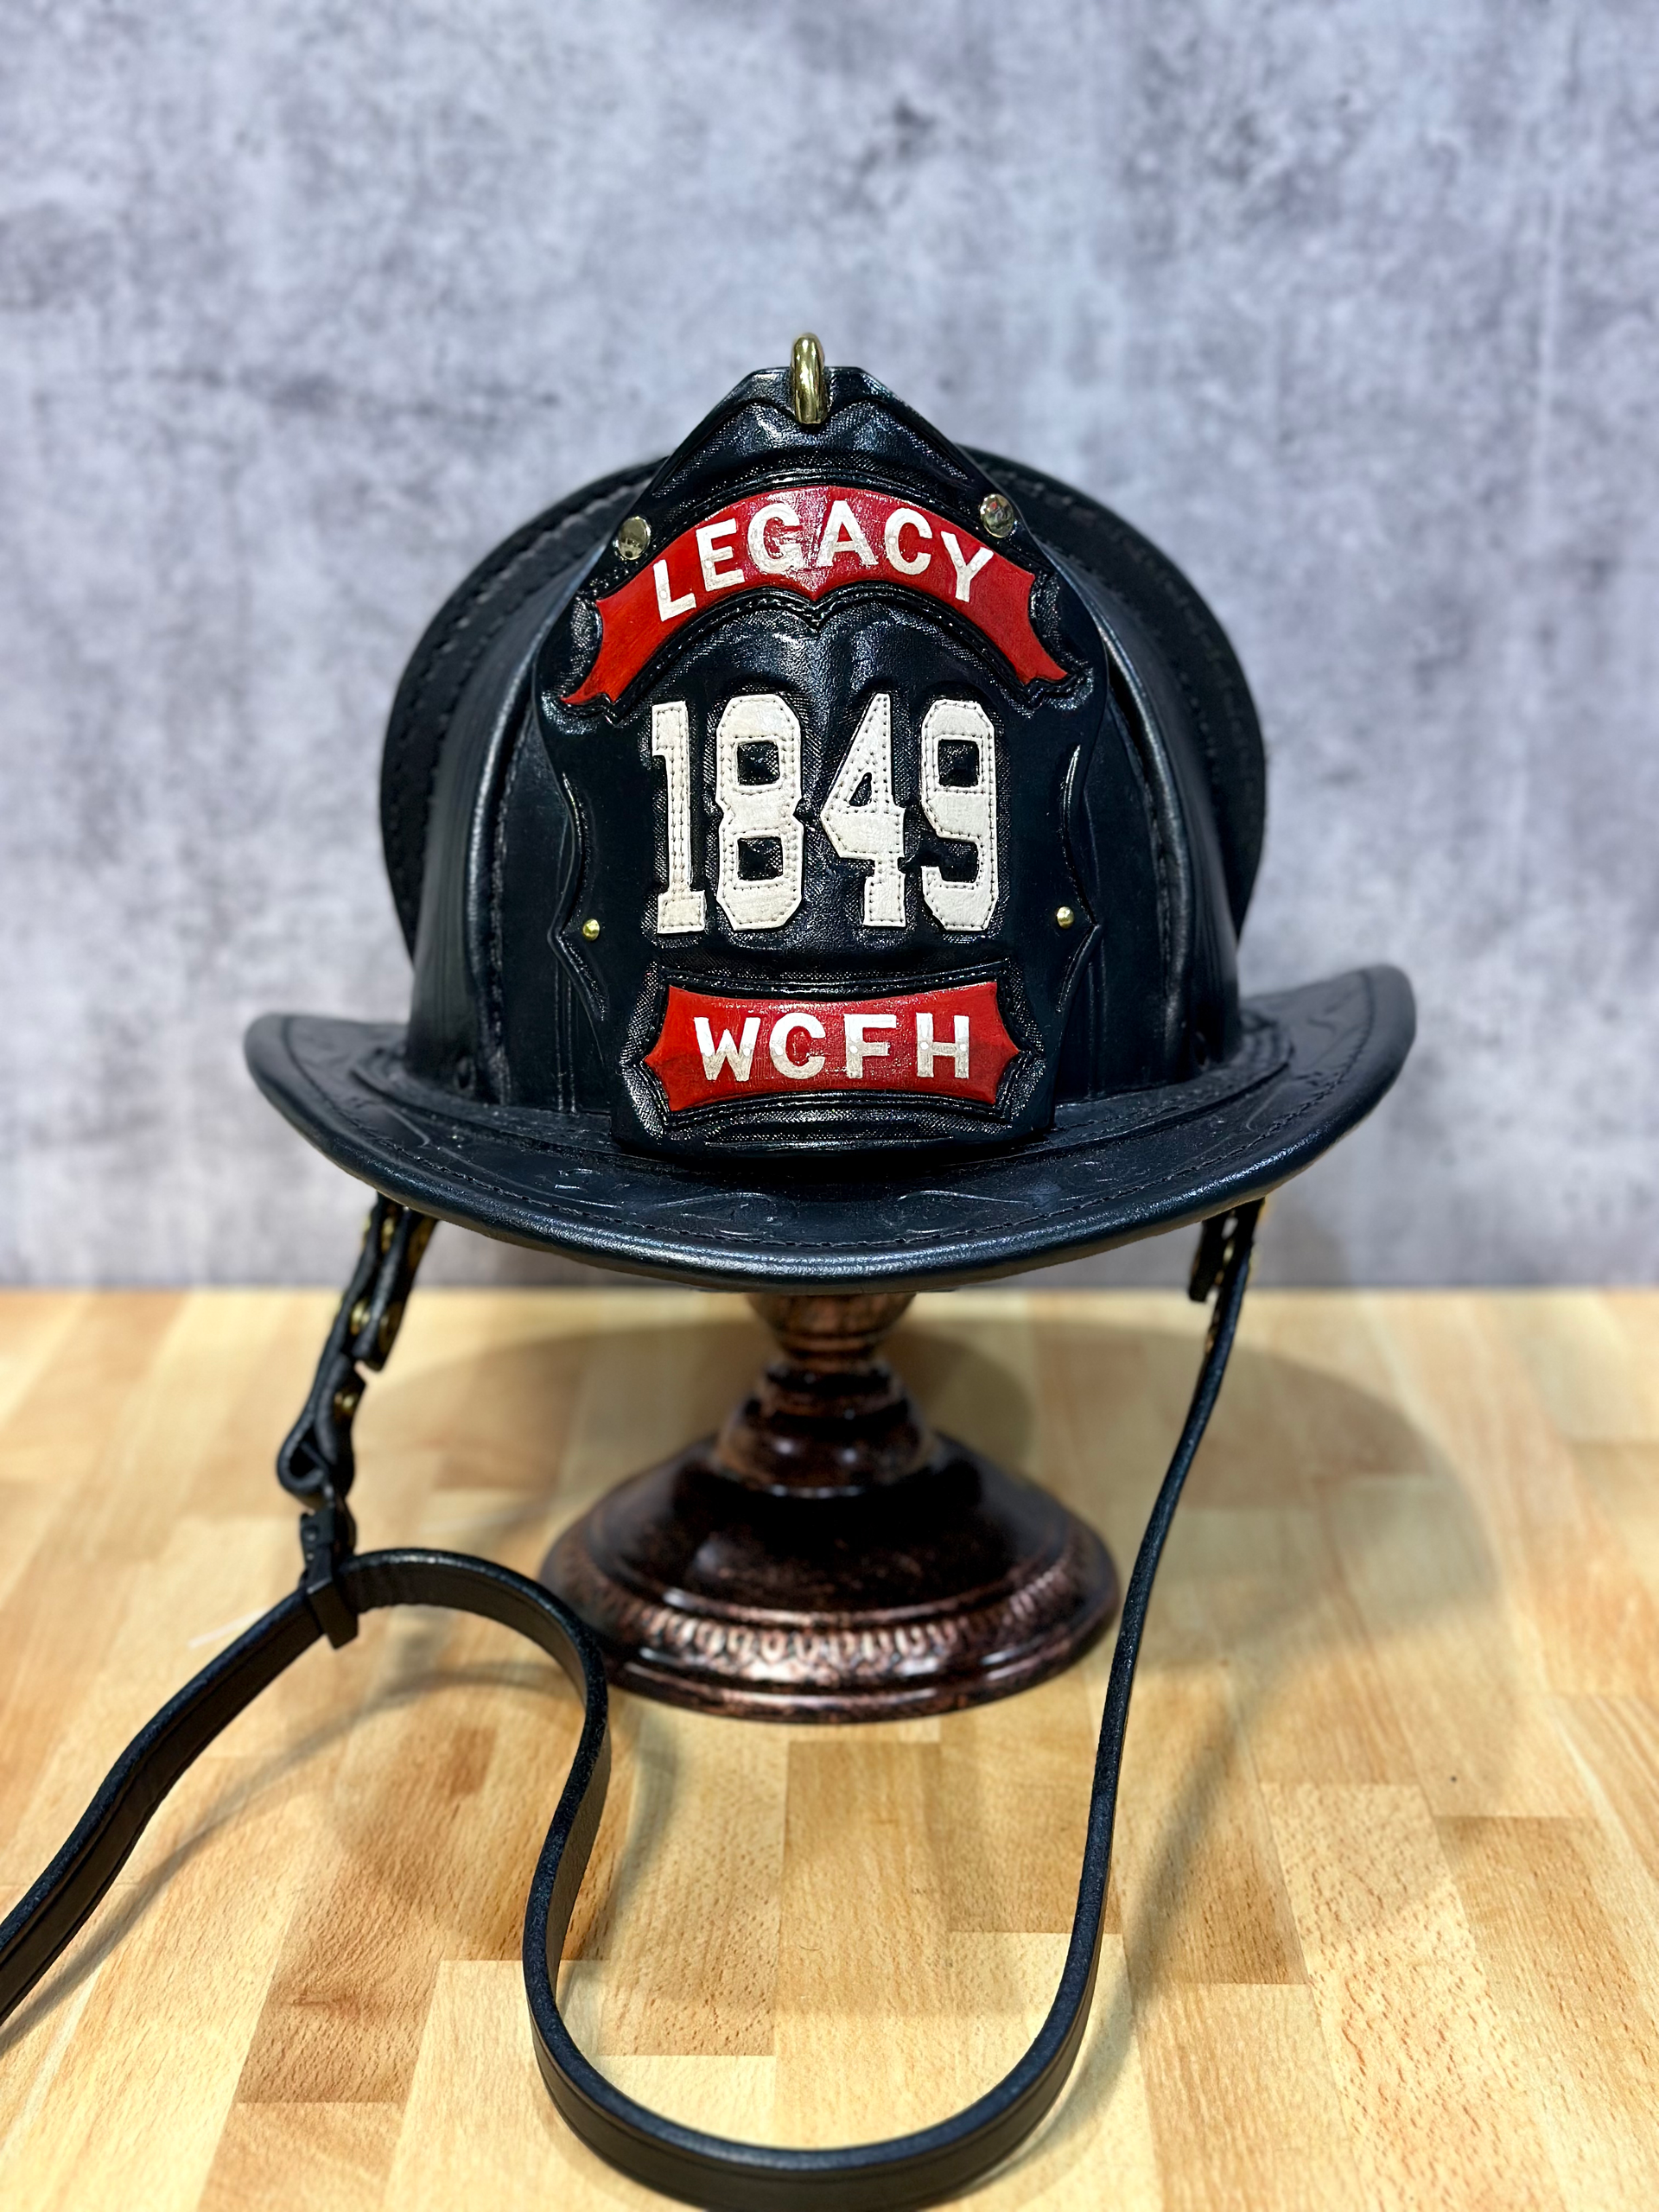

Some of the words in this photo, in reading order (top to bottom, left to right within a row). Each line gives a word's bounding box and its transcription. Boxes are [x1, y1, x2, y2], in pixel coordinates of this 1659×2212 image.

[652, 499, 994, 622] LEGACY
[652, 693, 1000, 934] 1849
[693, 1013, 970, 1082] WCFH
